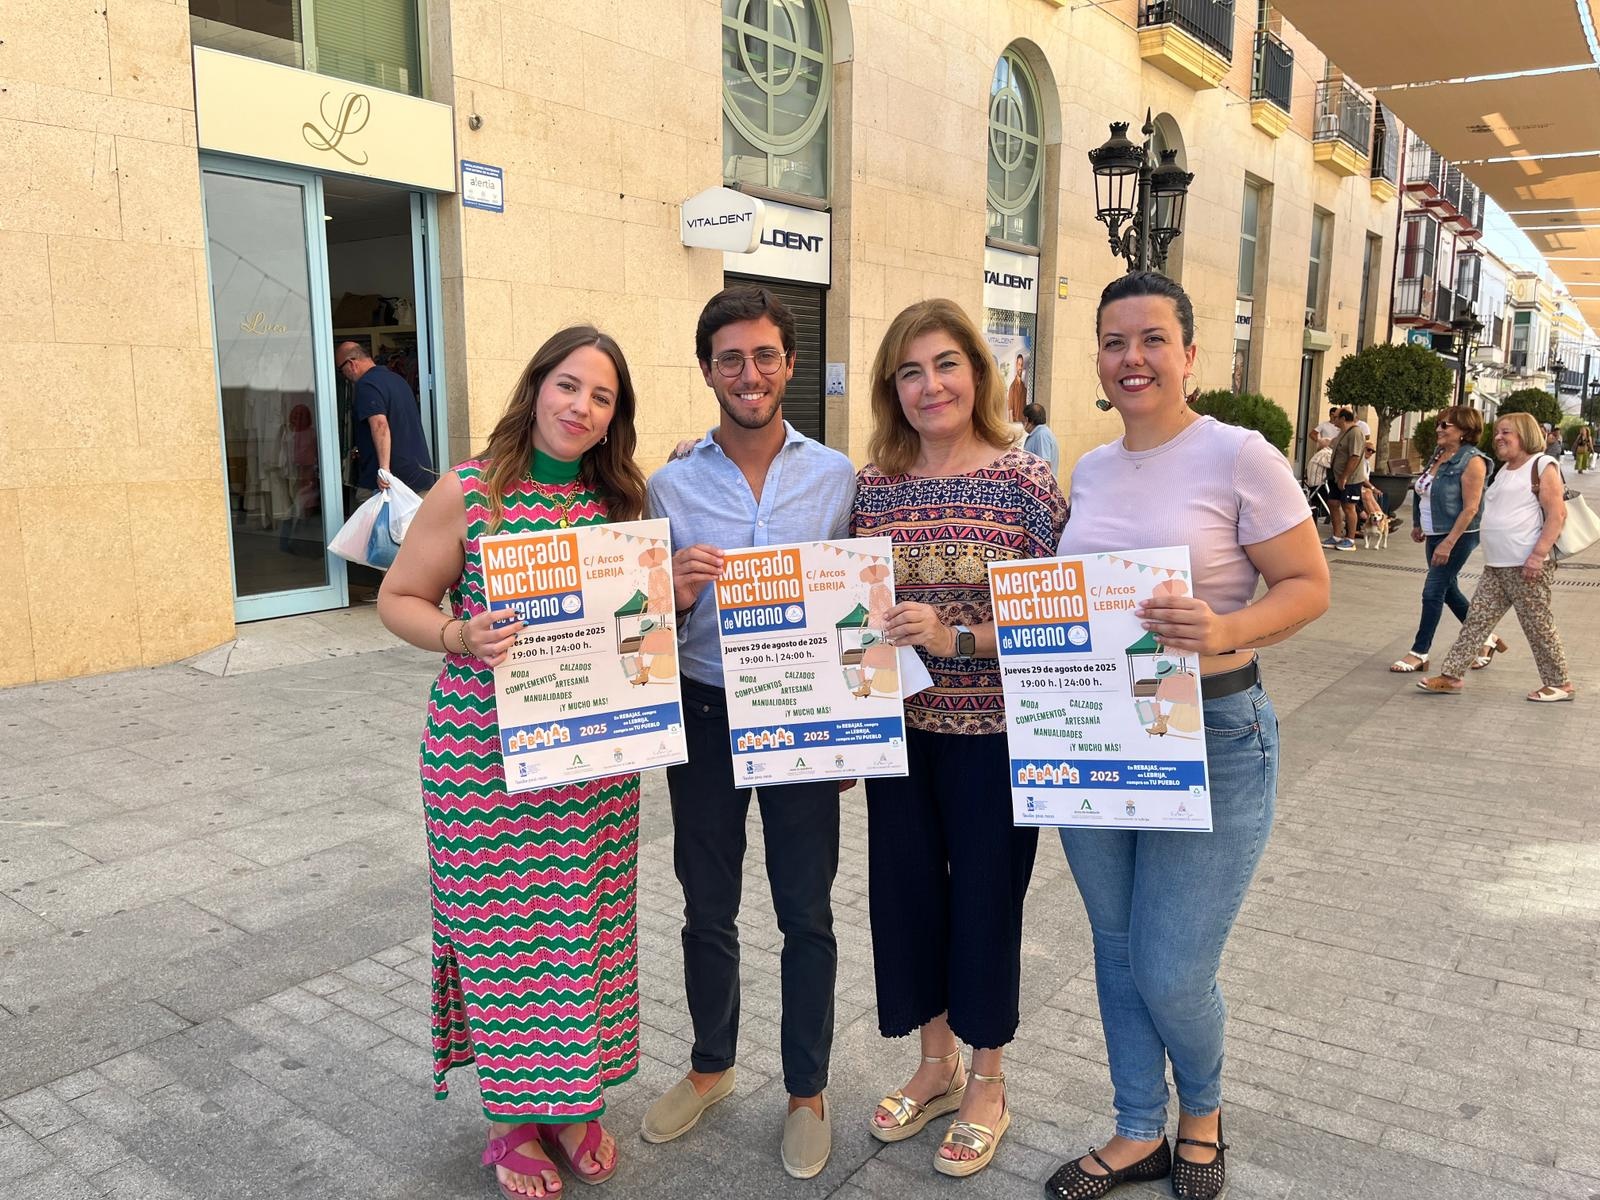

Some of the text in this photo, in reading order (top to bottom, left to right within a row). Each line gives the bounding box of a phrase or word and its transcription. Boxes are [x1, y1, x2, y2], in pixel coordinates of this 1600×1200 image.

[687, 212, 753, 228] VITALDENT
[984, 270, 1034, 290] TALDENT
[487, 535, 571, 570] Mercado
[583, 554, 624, 567] C/ Arcos
[719, 550, 794, 581] Mercado
[586, 567, 624, 580] LEBRIJA
[806, 569, 846, 580] C/ Arcos
[994, 562, 1077, 595] Mercado
[491, 565, 577, 597] Nocturno
[809, 581, 845, 592] LEBRIJA
[720, 578, 800, 605] Nocturno
[1090, 586, 1136, 598] C/ Arcos
[998, 594, 1084, 621] Nocturno
[1094, 599, 1136, 611] LEBRIJA
[724, 618, 734, 630] de
[524, 636, 534, 645] 29
[536, 635, 546, 643] de
[547, 631, 574, 641] agosto
[575, 629, 585, 637] de
[586, 626, 606, 636] 2025
[725, 637, 828, 654] Jueves 29 de agosto de 2025
[1002, 636, 1012, 649] de
[512, 649, 537, 660] 19:00
[540, 647, 548, 655] h.
[556, 643, 580, 653] 24:00
[583, 641, 592, 649] h.
[740, 656, 764, 665] 19:00
[765, 654, 774, 662] h.
[780, 652, 805, 661] 24:00
[806, 650, 815, 658] h.
[560, 663, 592, 671] CALZADOS
[1004, 663, 1117, 676] Jueves 29 de agosto de 2025
[511, 670, 529, 678] MODA
[739, 675, 757, 683] MODA
[785, 671, 816, 679] CALZADOS
[505, 673, 557, 695] COMPLEMENTOS
[555, 675, 589, 688] ARTESANÍA
[1020, 679, 1046, 688] 19:00
[1048, 678, 1057, 687] h.
[1064, 678, 1091, 687] 24:00
[1093, 677, 1102, 686] h.
[734, 679, 783, 698] COMPLEMENTOS
[780, 684, 813, 694] ARTESANÍA
[524, 691, 572, 703] MANUALIDADES
[751, 698, 797, 707] MANUALIDADES
[568, 700, 591, 710] MUCHO
[1020, 699, 1039, 710] MODA
[1069, 699, 1103, 711] CALZADOS
[793, 707, 815, 717] MUCHO
[1015, 708, 1067, 725] COMPLEMENTOS
[1065, 715, 1101, 725] ARTESANÍA
[580, 723, 608, 737] 2025
[803, 731, 830, 742] 2025
[1033, 728, 1083, 739] MANUALIDADES
[510, 725, 569, 750] REBAJAS
[738, 729, 793, 750] REBAJAS
[1078, 743, 1102, 752] MUCHO
[1019, 764, 1078, 783] REBAJAS
[1090, 770, 1120, 782] 2025
